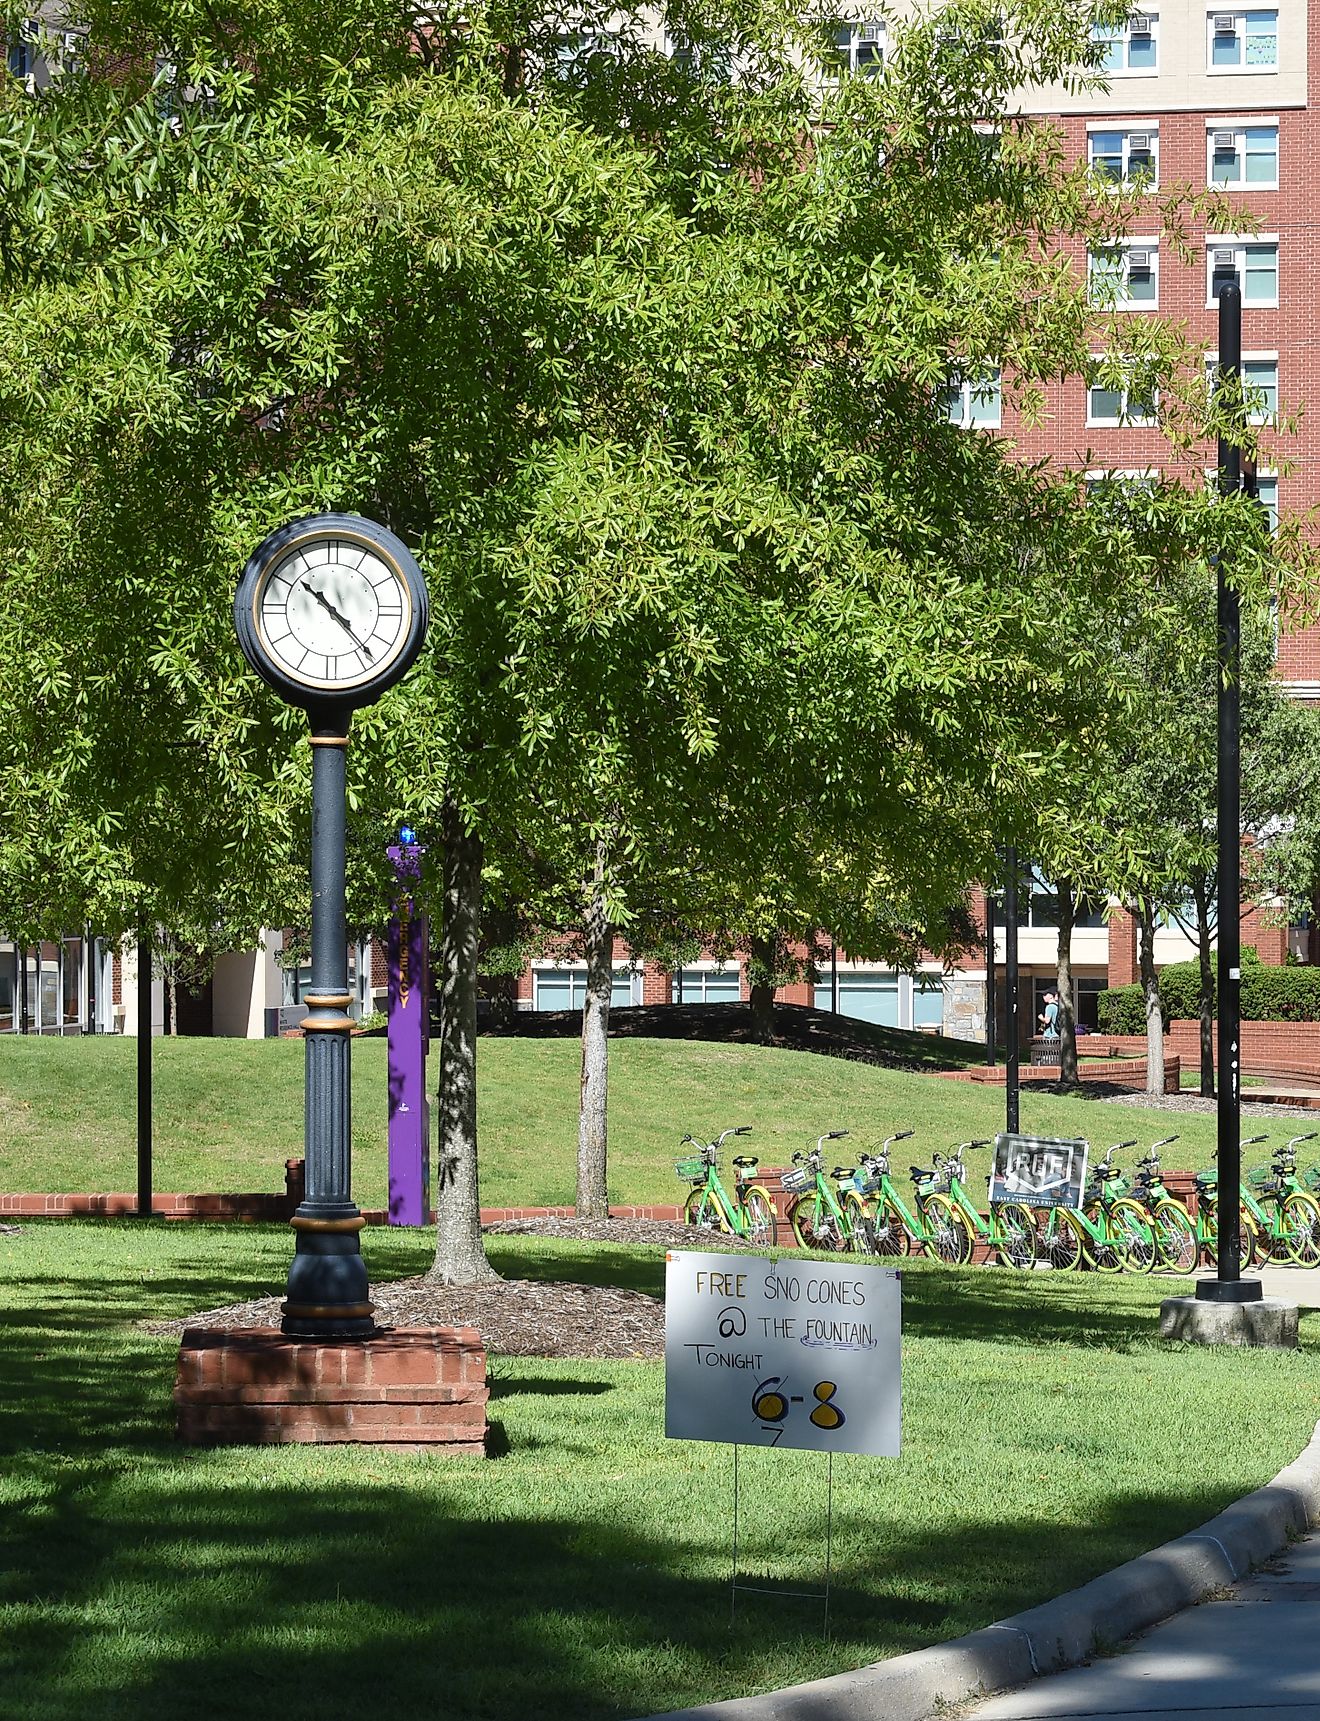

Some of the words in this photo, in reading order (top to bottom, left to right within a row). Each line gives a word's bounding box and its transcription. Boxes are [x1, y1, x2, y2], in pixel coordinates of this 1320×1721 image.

[1011, 1197, 1040, 1205] CAROLINA
[1041, 1200, 1075, 1208] UNIVERSITY
[696, 1271, 748, 1298] FREE
[763, 1275, 801, 1302] SNO
[806, 1279, 866, 1306] CONES
[716, 1306, 747, 1338] @
[757, 1317, 796, 1339] THE
[805, 1318, 874, 1345] FOUNTAIN
